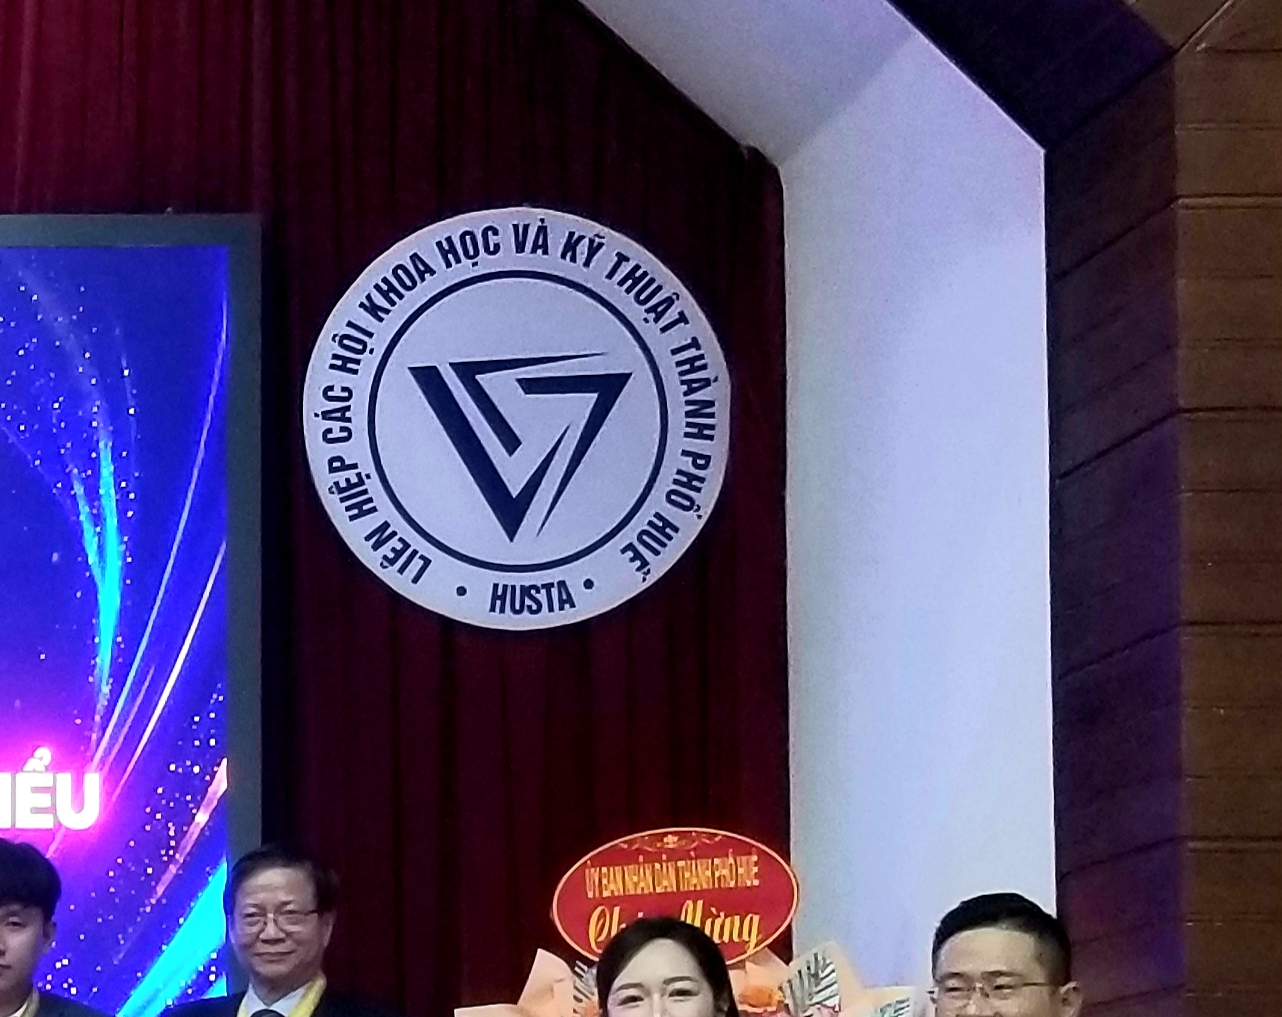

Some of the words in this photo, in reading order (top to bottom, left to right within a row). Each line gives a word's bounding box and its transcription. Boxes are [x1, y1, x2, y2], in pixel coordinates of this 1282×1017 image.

[435, 224, 501, 270] HỌC
[511, 217, 550, 256] VÀ
[560, 232, 606, 269] KỸ
[358, 252, 436, 323] KHOA
[604, 251, 690, 335] THUẬT
[328, 321, 375, 376] HỘI
[314, 384, 354, 445] CÁC
[670, 336, 720, 442] THÀNH
[327, 455, 378, 522] HIỆP
[665, 449, 713, 520] PHỐ
[363, 519, 433, 585] LIÊN
[619, 512, 681, 583] HUẾ
[488, 579, 577, 616] HUSTA
[601, 867, 623, 897] BAN
[677, 851, 713, 891] THÀNH
